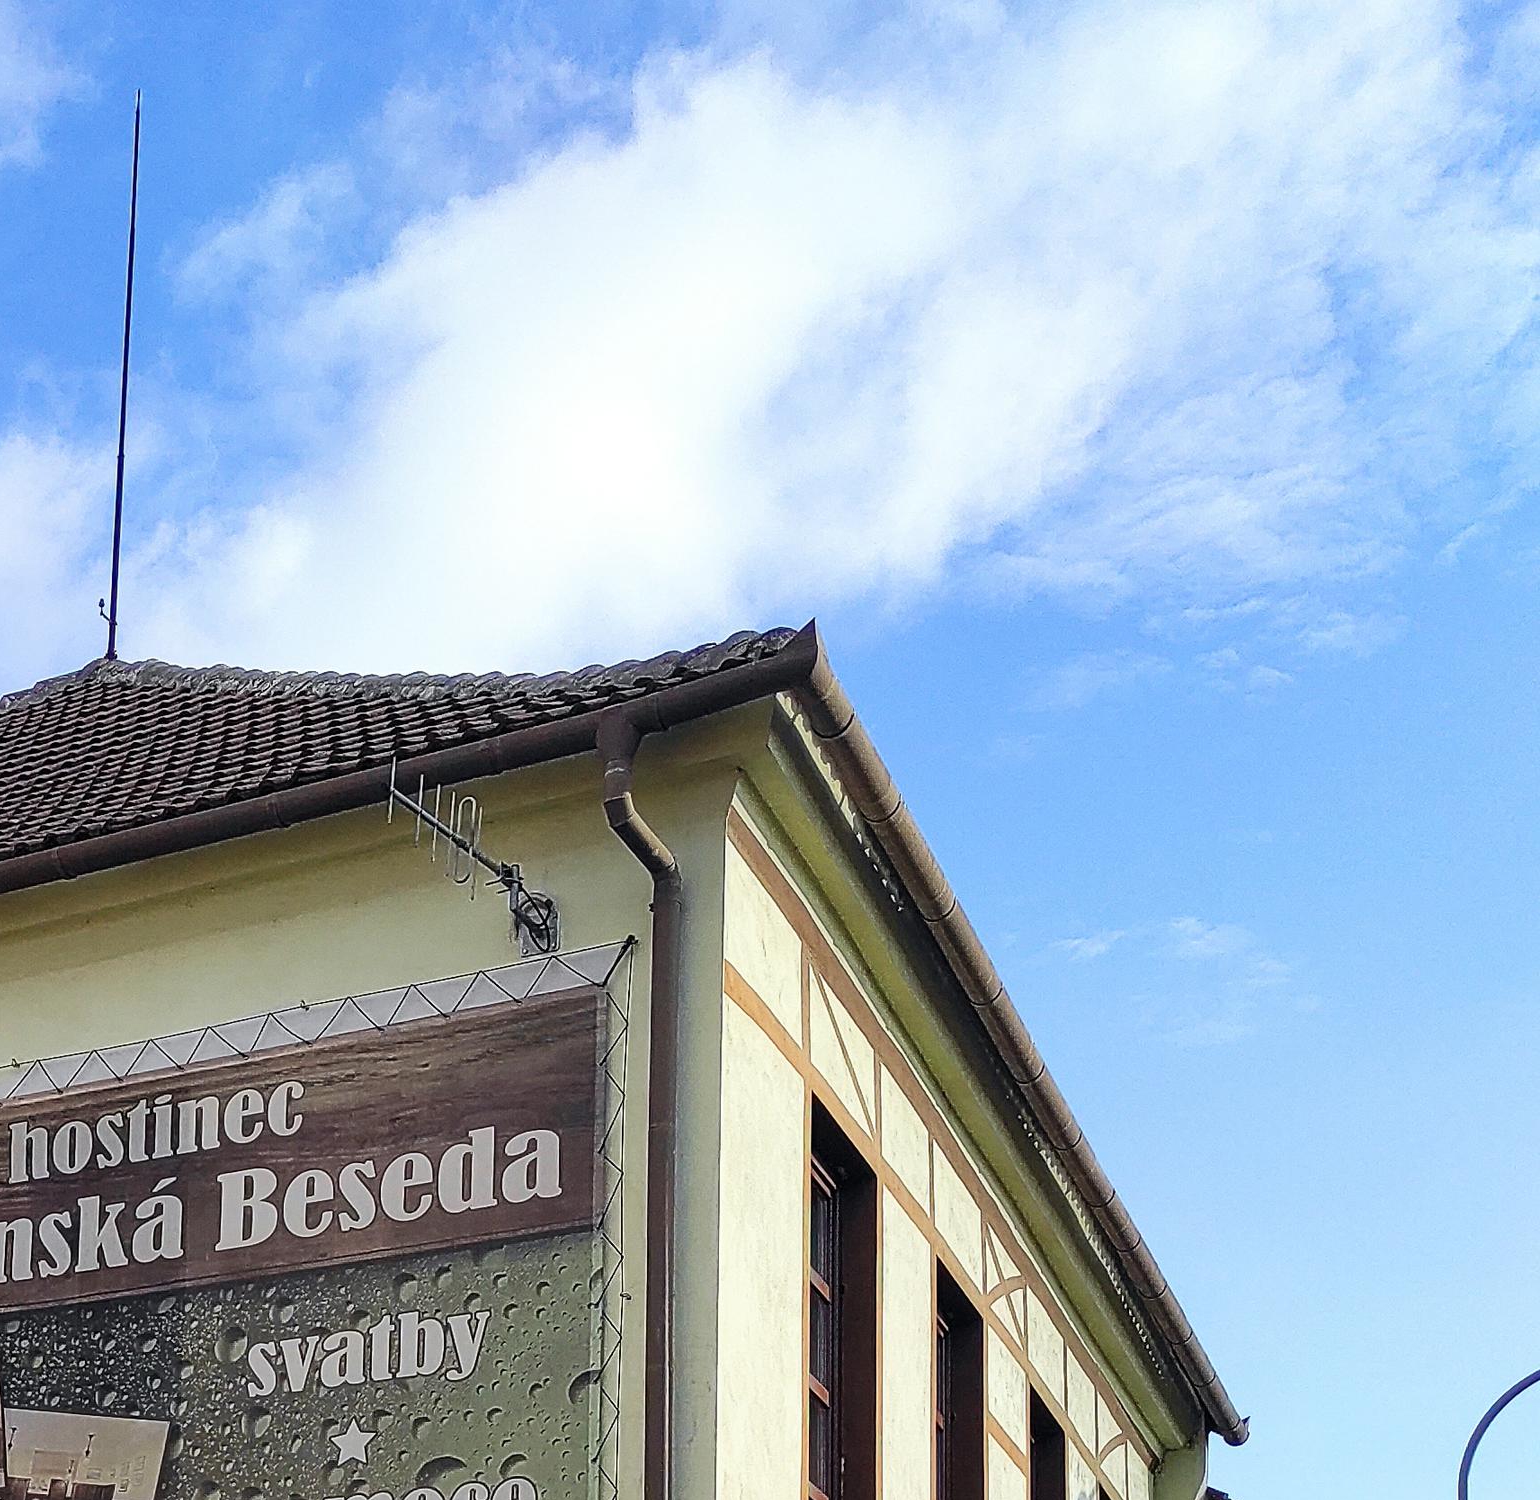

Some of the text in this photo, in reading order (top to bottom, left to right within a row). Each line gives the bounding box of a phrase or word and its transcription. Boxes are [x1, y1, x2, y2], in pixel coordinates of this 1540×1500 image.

[8, 1080, 305, 1184] hostinec
[214, 1126, 563, 1252] Beseda
[247, 1310, 492, 1398] svatby
